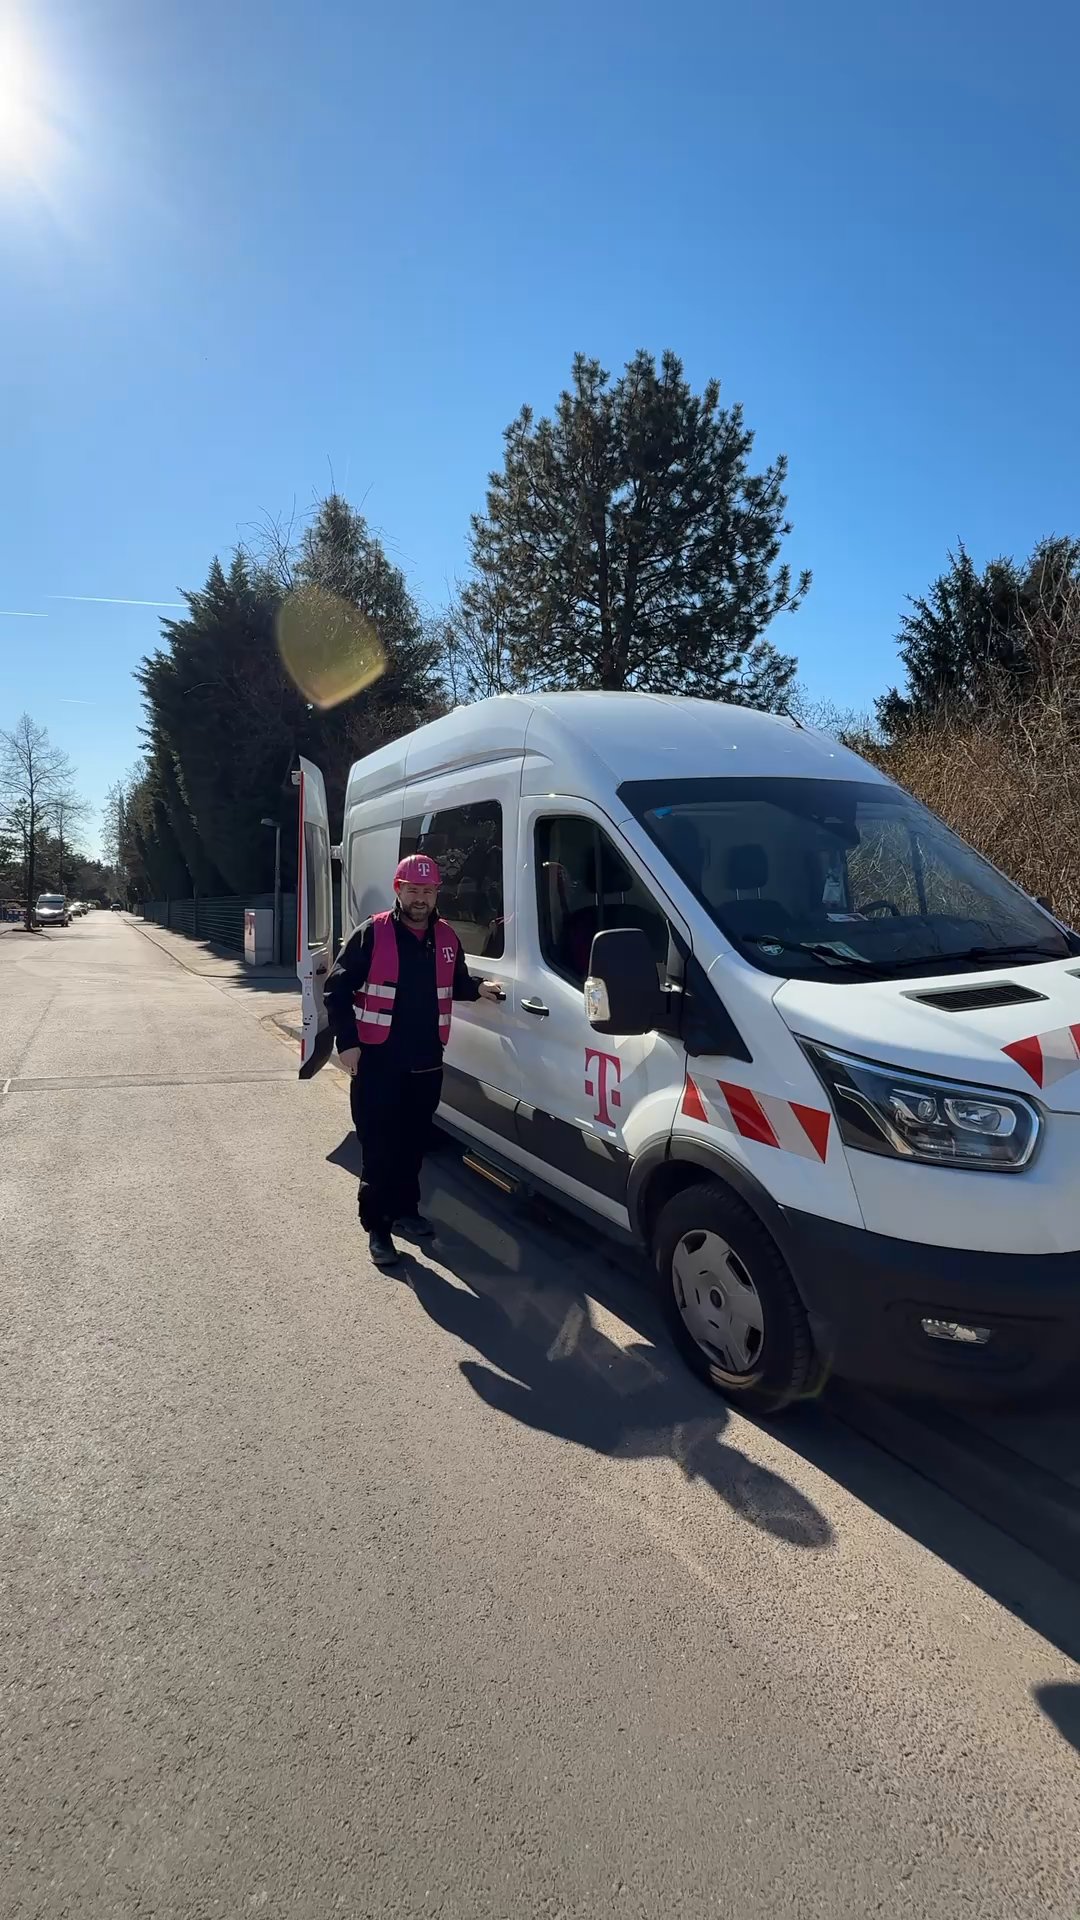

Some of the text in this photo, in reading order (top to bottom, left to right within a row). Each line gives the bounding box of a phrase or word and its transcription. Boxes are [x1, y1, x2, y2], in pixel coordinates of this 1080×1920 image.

[417, 862, 430, 877] T
[441, 946, 455, 963] T
[584, 1047, 622, 1129] T
